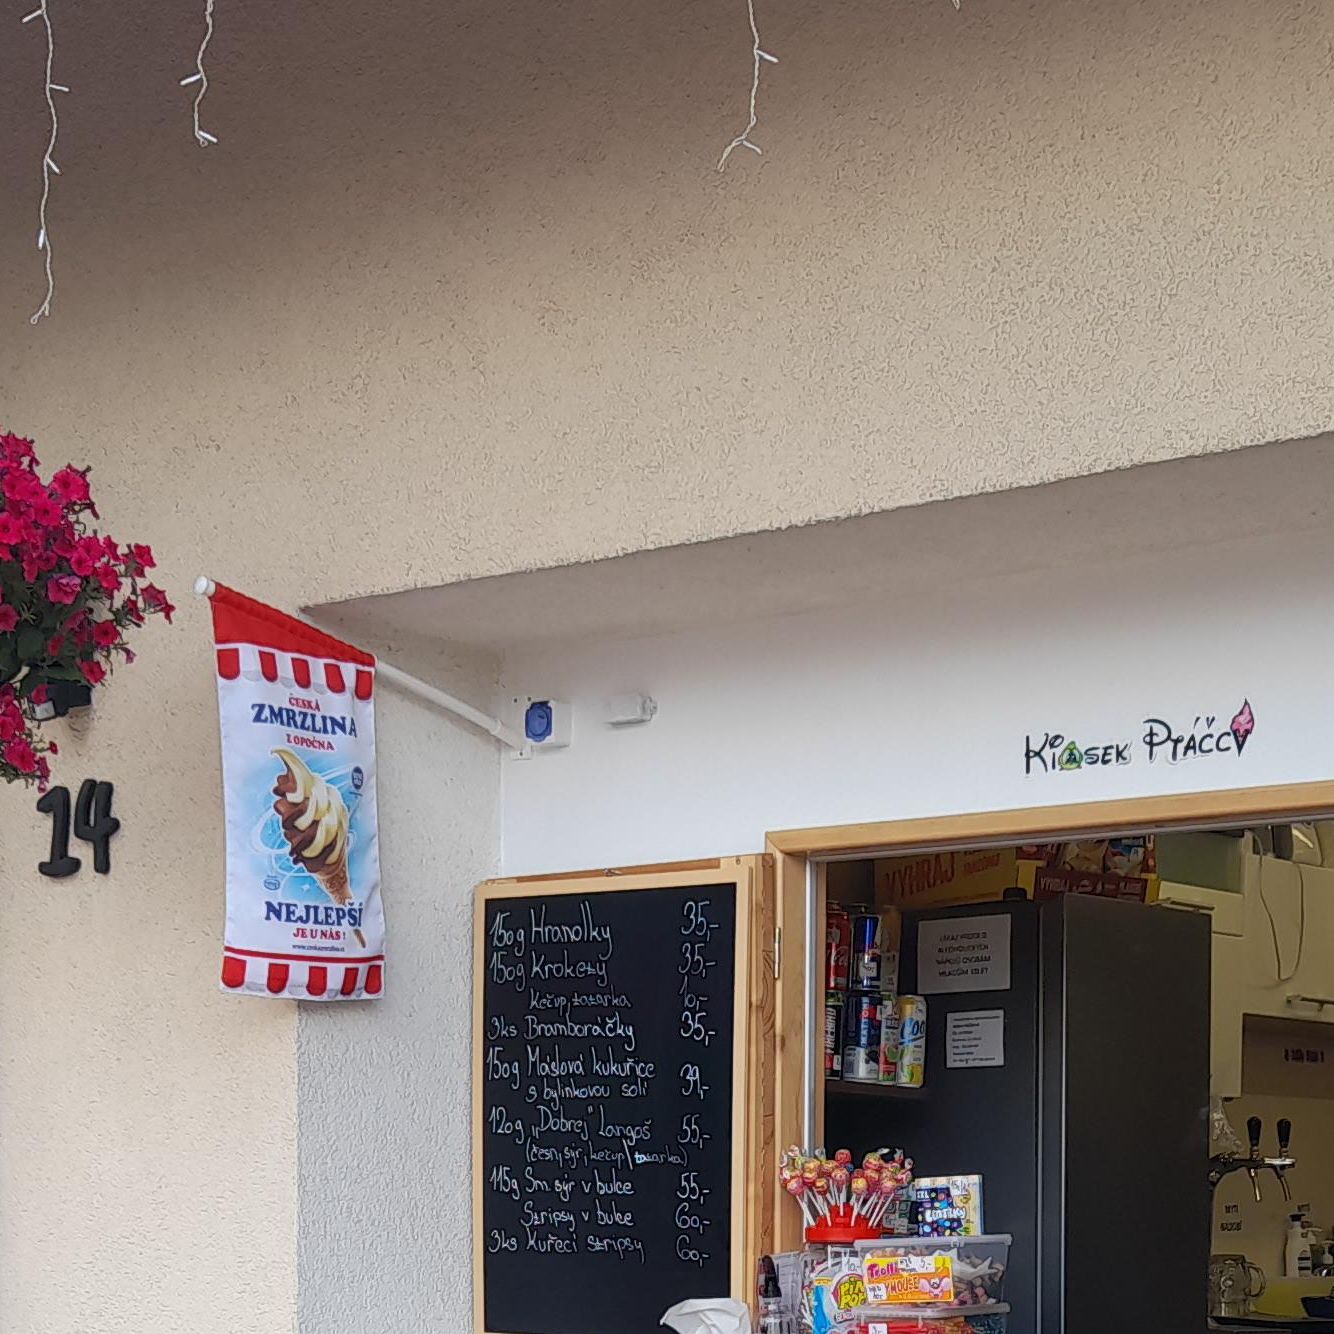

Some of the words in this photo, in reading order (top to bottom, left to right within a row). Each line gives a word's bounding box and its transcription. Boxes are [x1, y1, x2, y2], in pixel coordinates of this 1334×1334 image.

[250, 702, 358, 738] ZMRZLINA
[36, 778, 121, 877] 14
[264, 900, 364, 928] NEJLEPŠÍ
[292, 927, 308, 939] JE
[309, 928, 318, 939] U
[530, 899, 613, 960] Hranolky
[680, 900, 720, 942] 35,-
[529, 950, 608, 988] Krokety
[677, 943, 717, 978] 35,-
[486, 1015, 518, 1040] 3ks
[524, 1011, 636, 1051] Bramboráčky
[680, 1010, 717, 1047] 35,-
[526, 1045, 586, 1078] Máslová
[591, 1046, 657, 1079] kukuřice
[525, 1084, 539, 1103] s
[542, 1077, 611, 1111] bylinkovou
[487, 1105, 526, 1144] 120g
[597, 1104, 654, 1147] Langoš
[676, 1113, 712, 1150] 55,-
[580, 1181, 592, 1194] v
[593, 1167, 636, 1196] bulce
[676, 1171, 711, 1205] 55,-
[519, 1200, 576, 1233] Stripsy
[580, 1211, 590, 1223] v
[594, 1199, 635, 1227] bulce
[674, 1201, 712, 1235] 60,-
[487, 1229, 519, 1254] 3ks
[676, 1234, 711, 1269] 60,-
